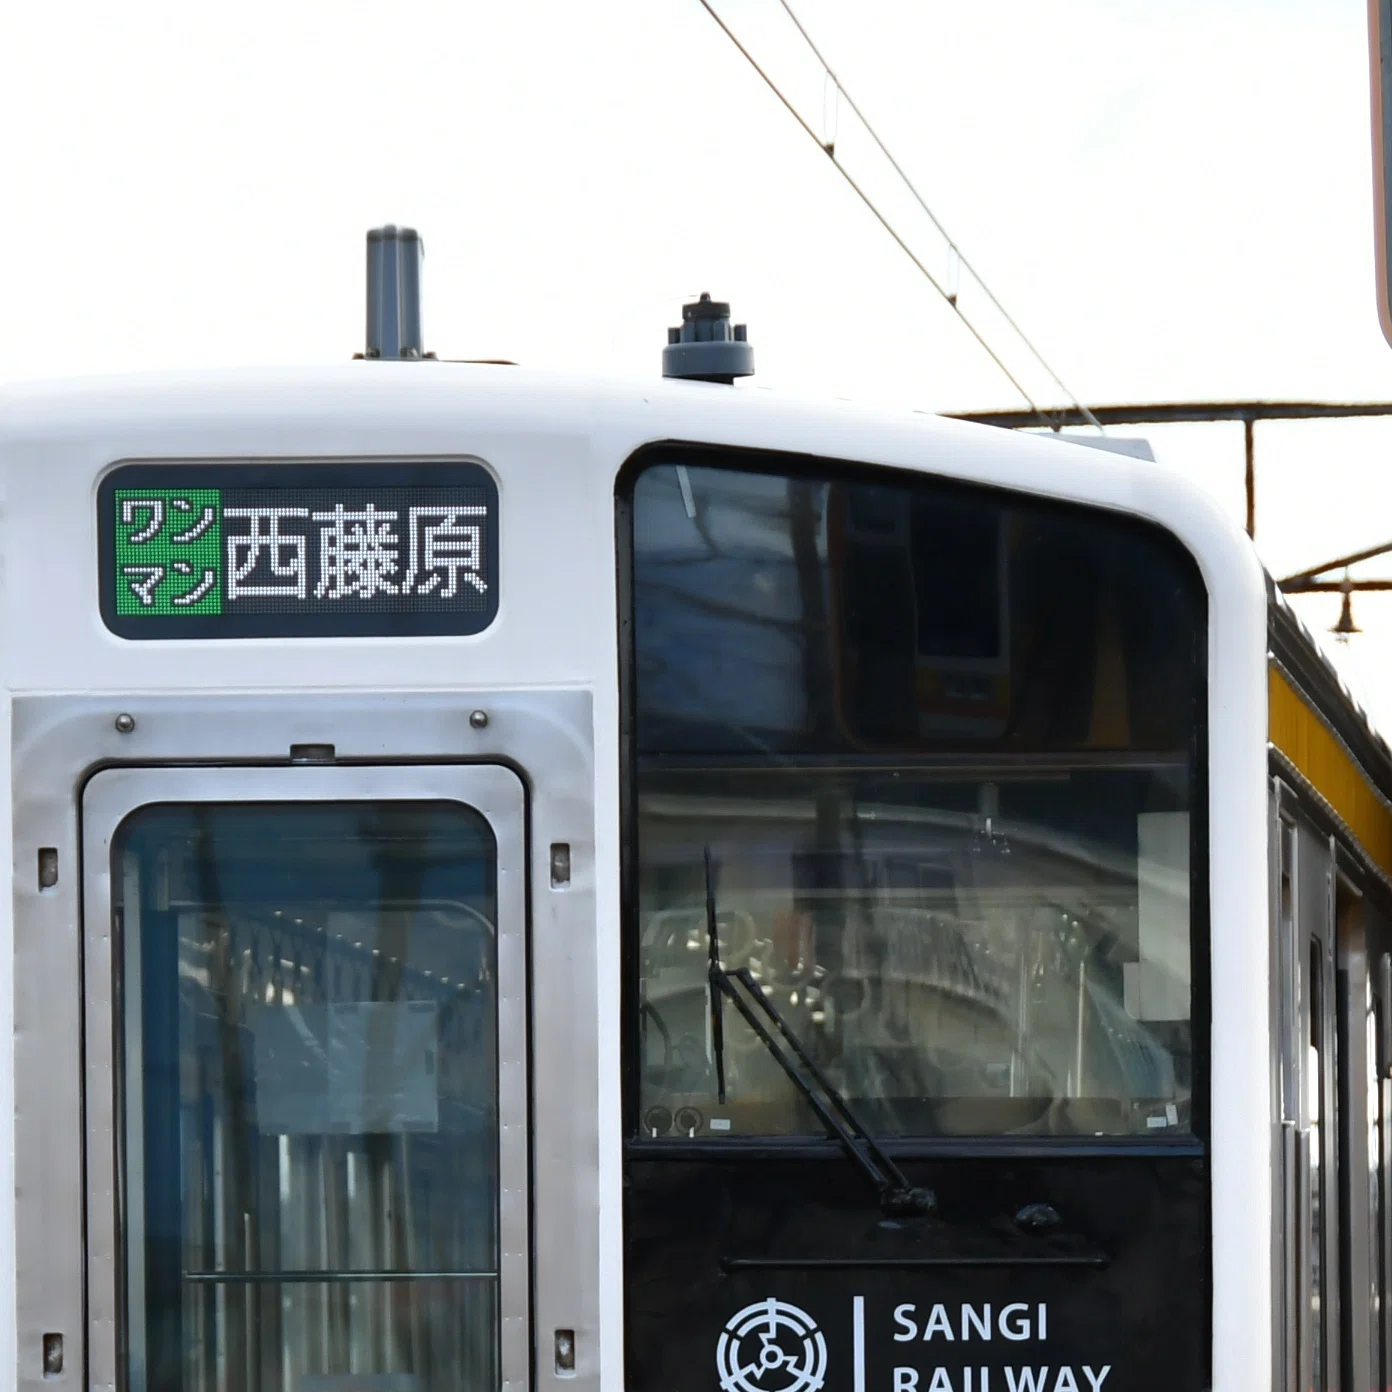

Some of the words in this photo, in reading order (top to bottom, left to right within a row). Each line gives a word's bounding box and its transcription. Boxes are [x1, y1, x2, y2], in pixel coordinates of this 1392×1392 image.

[122, 499, 214, 543] ワン
[223, 503, 488, 600] 西藤原
[122, 563, 214, 606] マン
[893, 1302, 1048, 1342] SANGI
